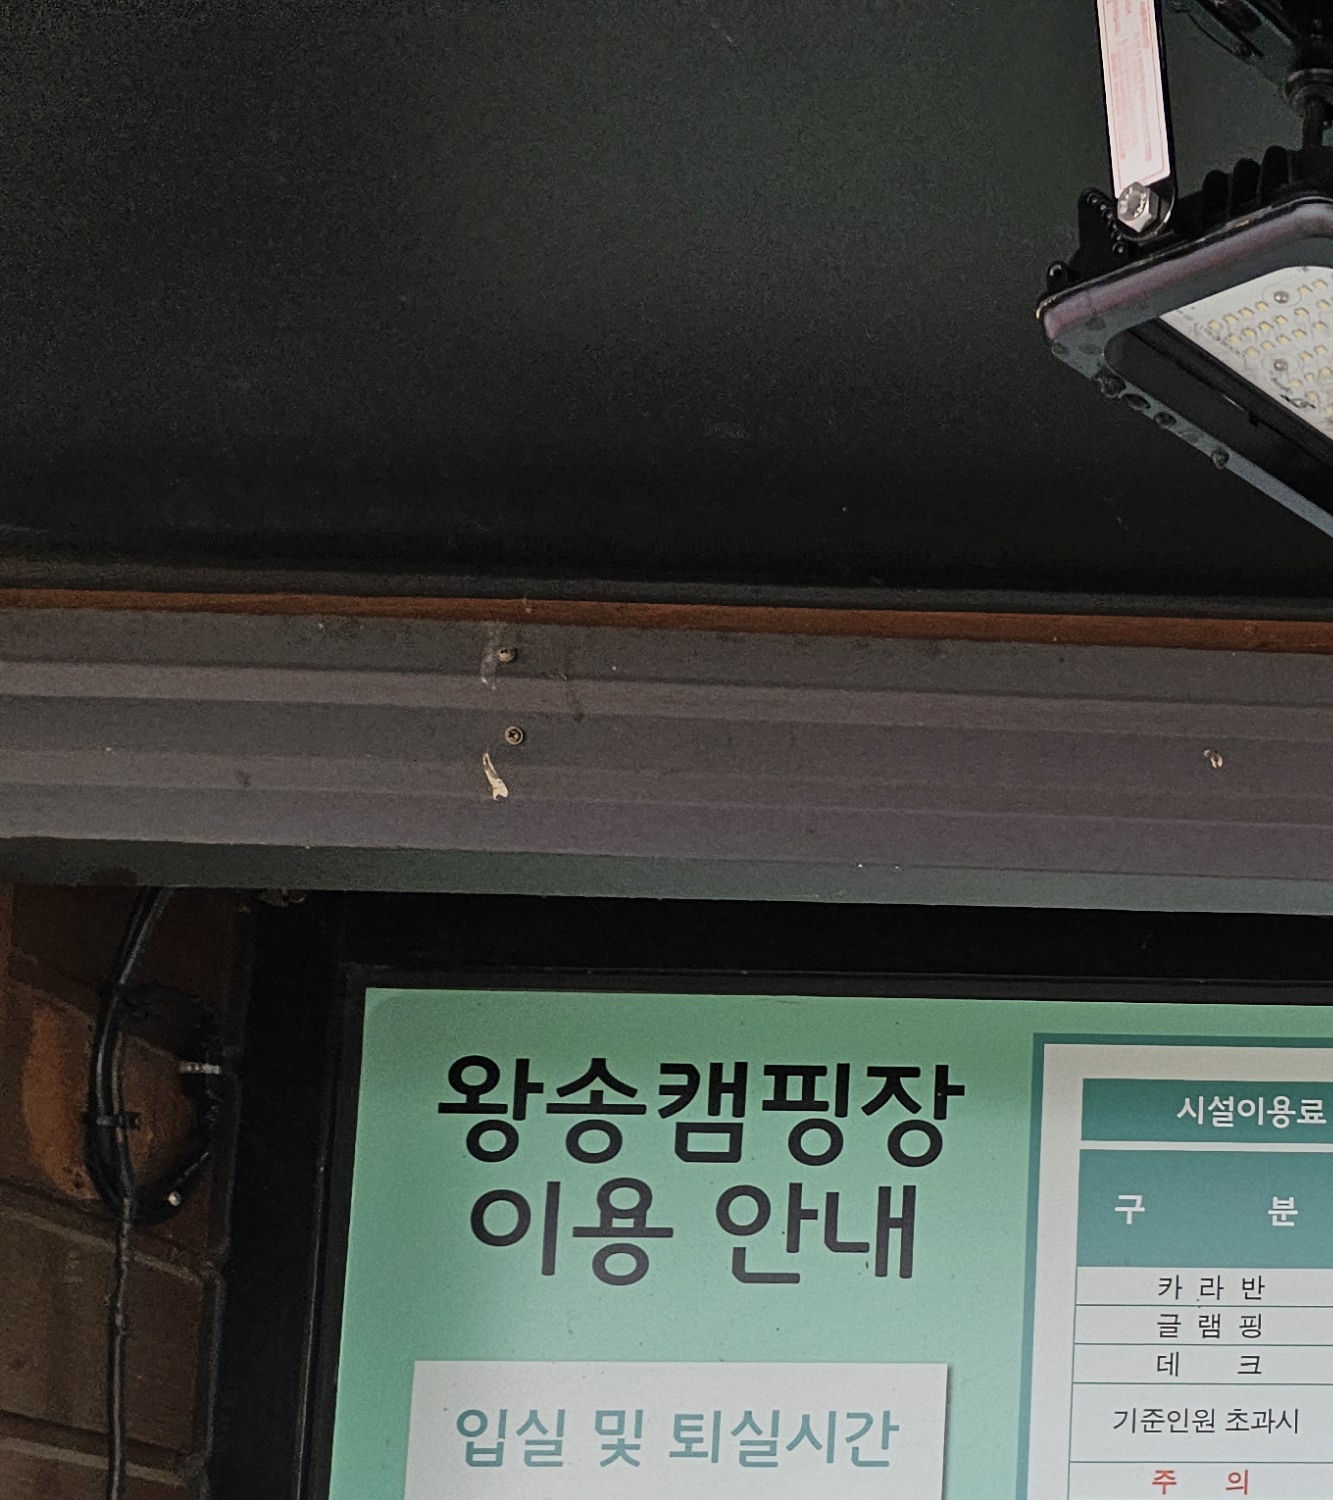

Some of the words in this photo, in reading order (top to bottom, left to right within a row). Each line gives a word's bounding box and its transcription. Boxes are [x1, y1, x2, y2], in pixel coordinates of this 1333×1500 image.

[438, 1055, 965, 1167] 왕송캠핑장
[1177, 1096, 1327, 1128] 시설이용료
[470, 1178, 673, 1285] 이용
[716, 1183, 916, 1283] 안내
[456, 1409, 565, 1467] 입실
[595, 1409, 643, 1467] 및
[669, 1410, 899, 1467] 퇴실시간
[1114, 1408, 1215, 1433] 기준인원
[1225, 1409, 1298, 1433] 초과시
